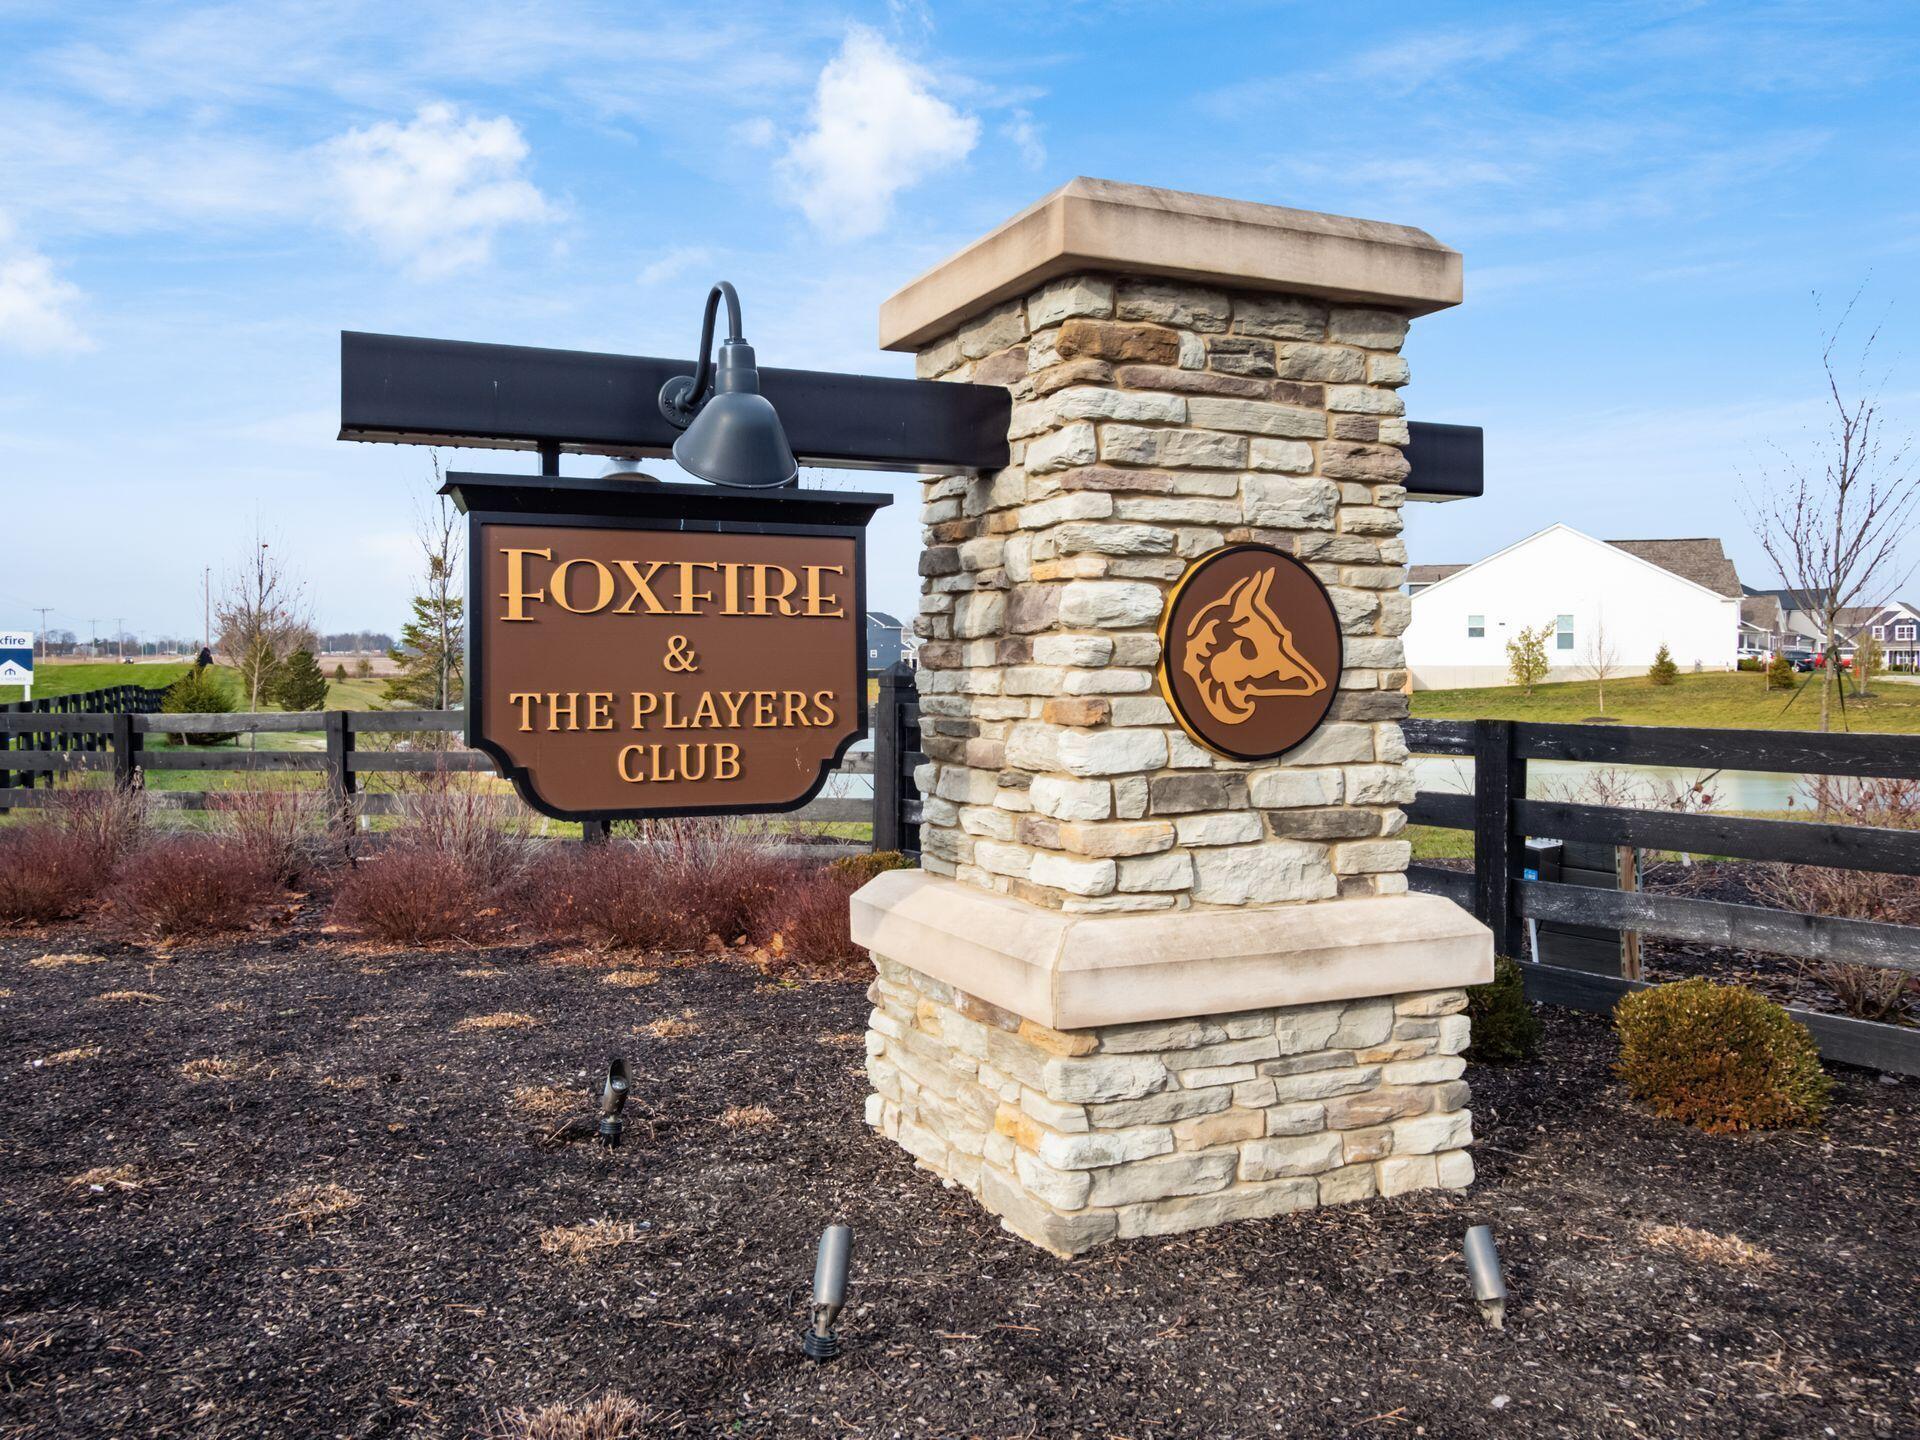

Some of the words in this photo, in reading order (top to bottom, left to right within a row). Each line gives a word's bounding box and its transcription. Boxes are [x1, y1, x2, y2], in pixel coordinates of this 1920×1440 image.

[499, 547, 844, 621] FOXFIRE
[662, 634, 698, 672] &
[509, 692, 614, 731] THE
[631, 690, 835, 729] PLAYERS
[617, 742, 741, 783] CLUB
